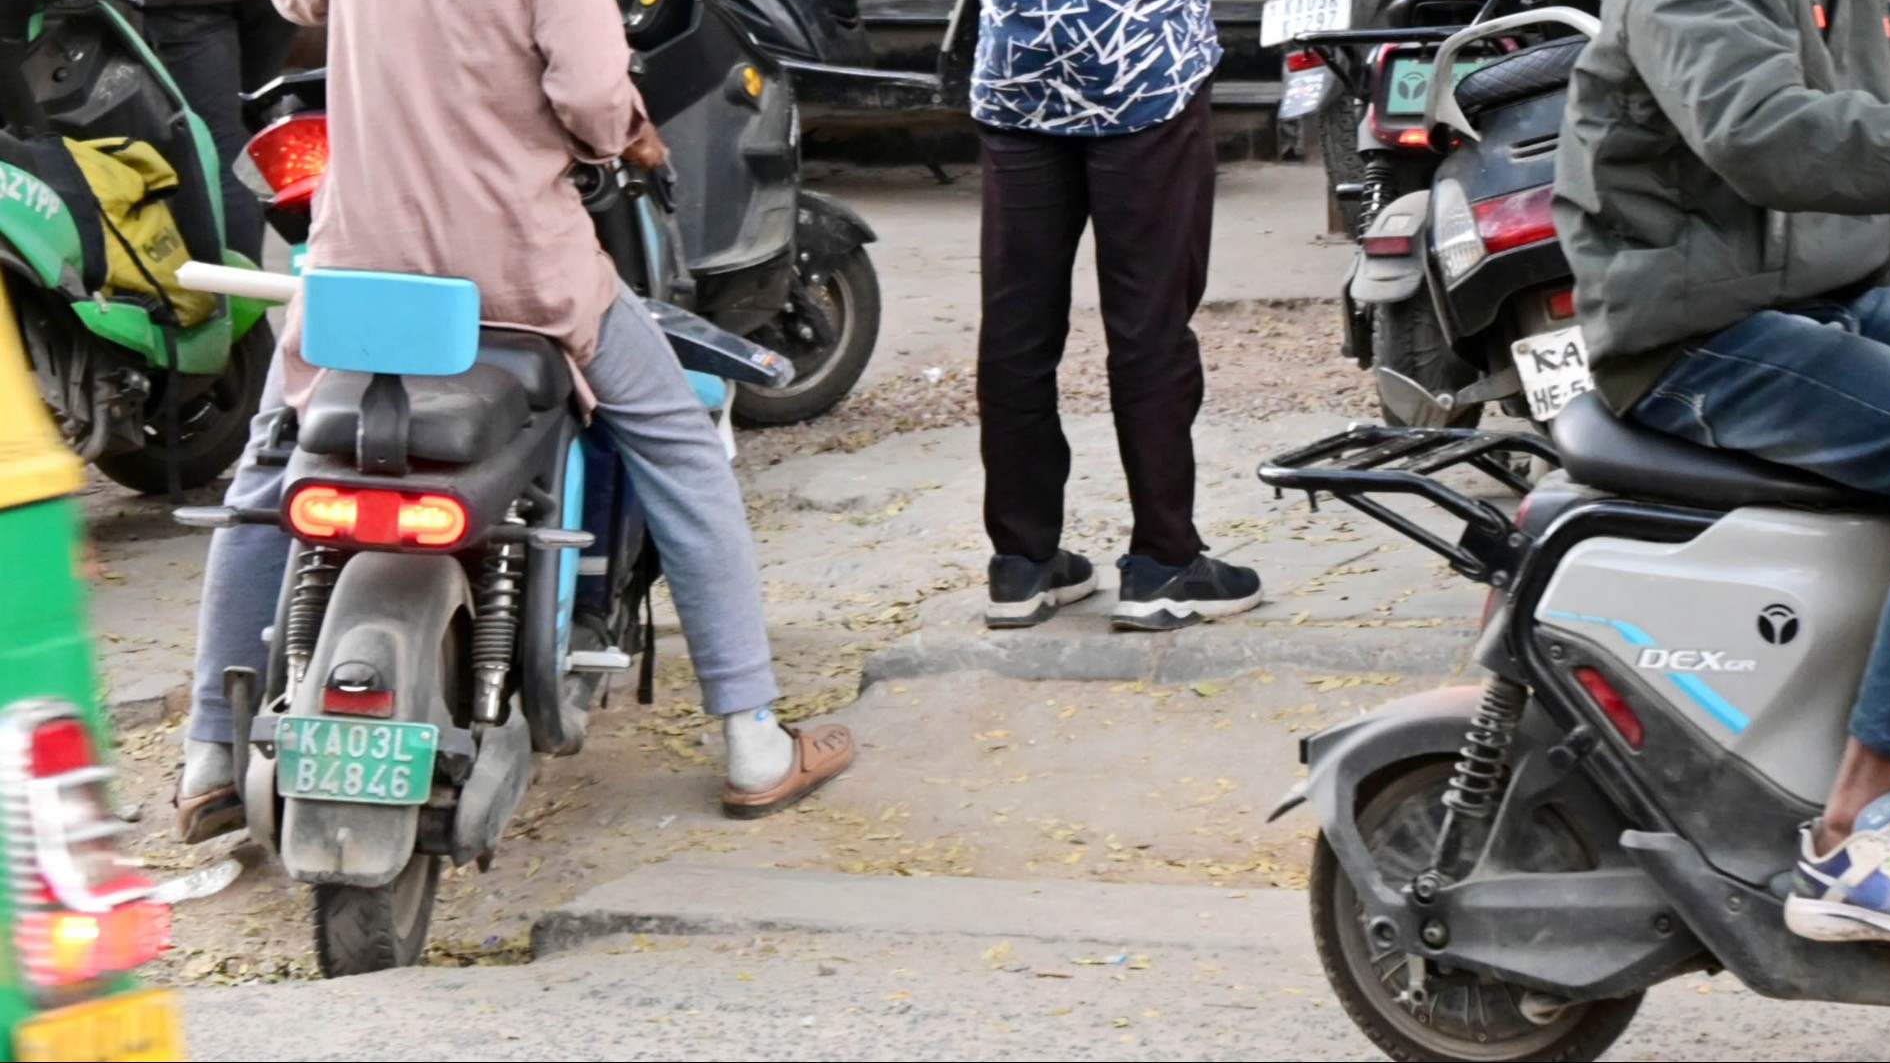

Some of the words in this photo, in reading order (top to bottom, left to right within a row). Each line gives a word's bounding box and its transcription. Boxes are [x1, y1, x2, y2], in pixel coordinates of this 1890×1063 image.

[8, 171, 62, 221] ZYPP
[1531, 341, 1584, 374] KA
[1638, 648, 1726, 671] DEX
[300, 721, 413, 762] KA03L
[296, 757, 411, 799] B4846
